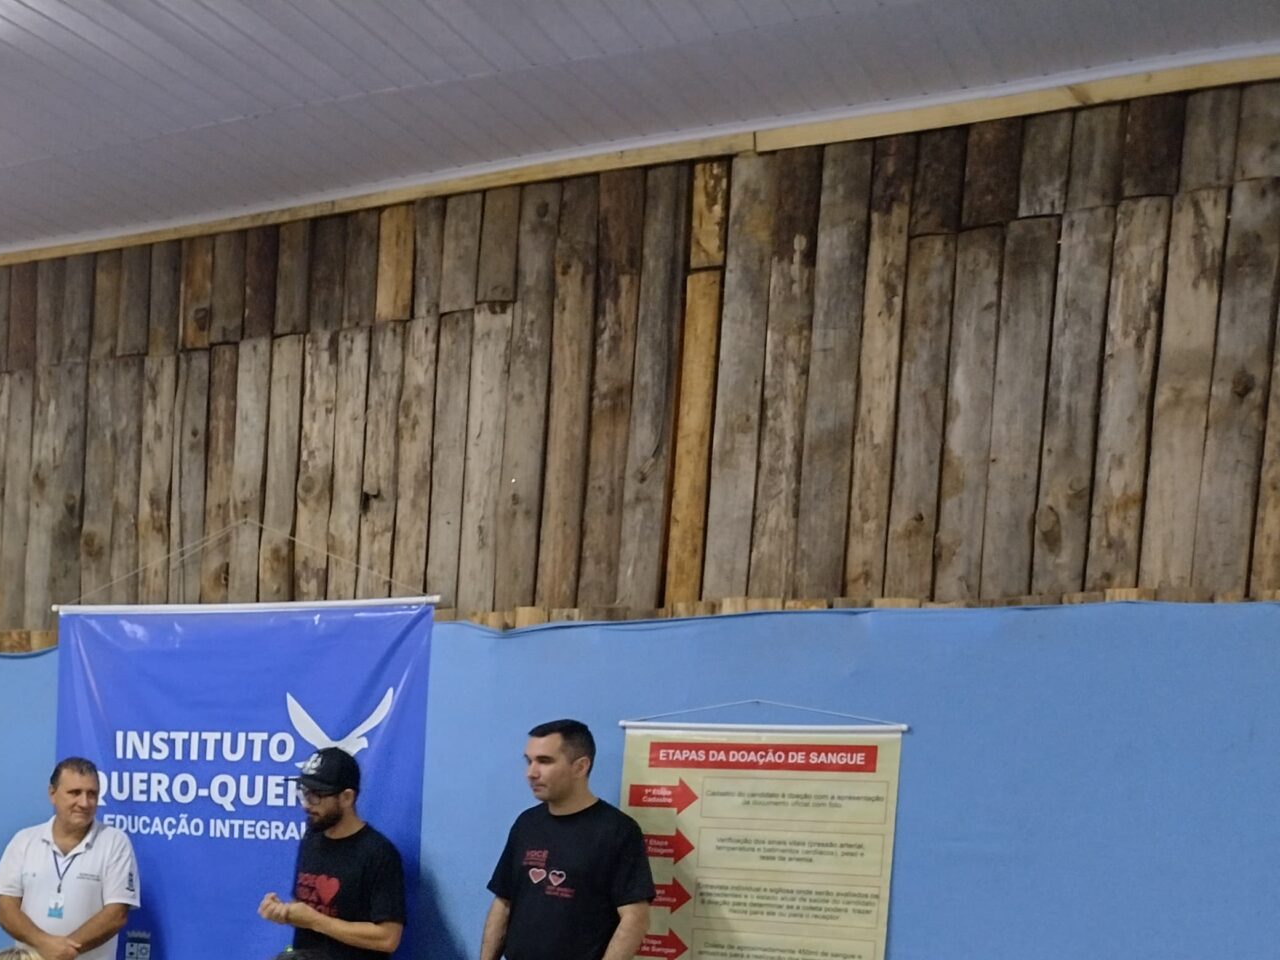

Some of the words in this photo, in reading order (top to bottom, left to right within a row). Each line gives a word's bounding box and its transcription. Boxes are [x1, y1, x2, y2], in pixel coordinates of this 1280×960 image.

[116, 731, 295, 762] INSTITUTO
[659, 749, 706, 762] ETAPAS
[709, 751, 726, 763] DA
[729, 749, 785, 766] DOAÇÃO
[788, 753, 806, 764] DE
[809, 752, 866, 765] SANGUE
[103, 814, 204, 840] EDUCAÇÃO
